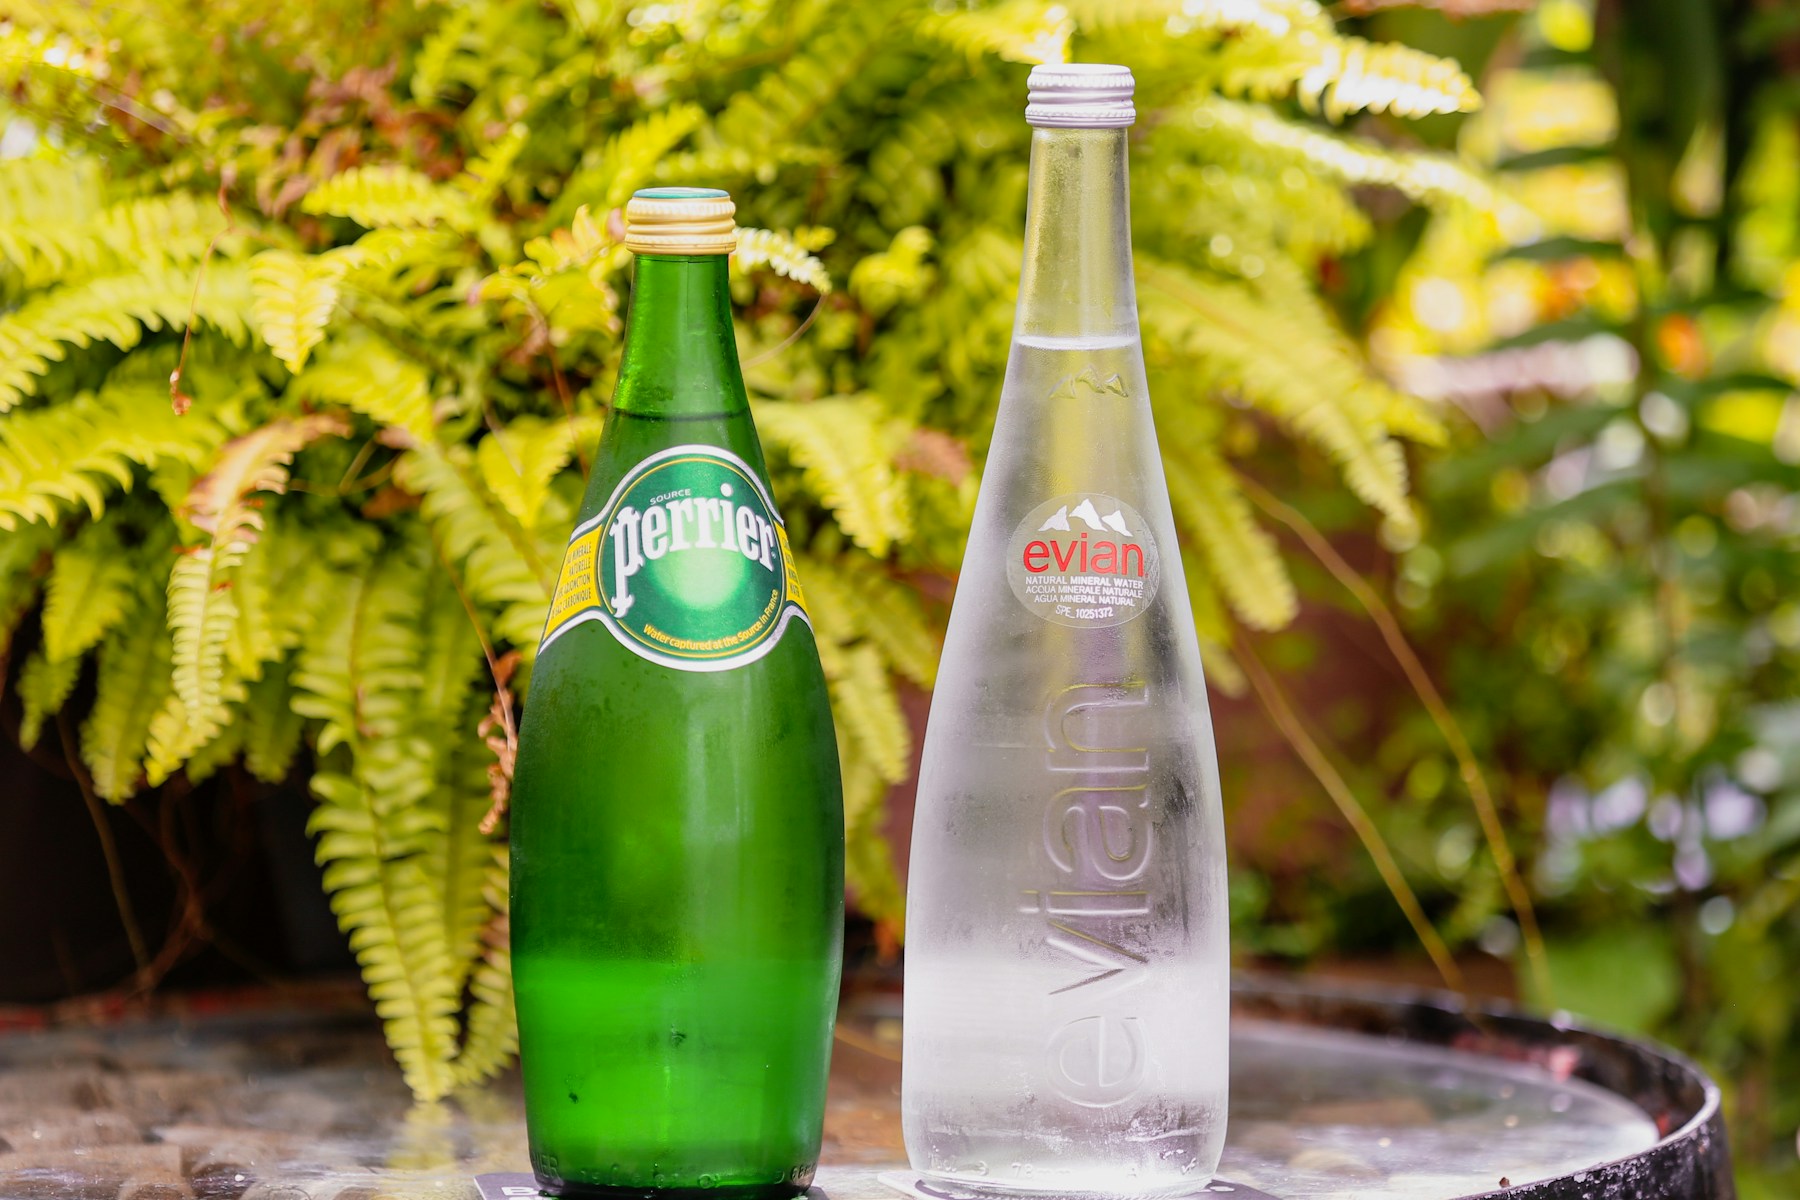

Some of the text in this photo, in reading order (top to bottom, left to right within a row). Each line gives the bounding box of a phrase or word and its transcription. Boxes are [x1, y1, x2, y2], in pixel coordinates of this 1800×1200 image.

[649, 488, 691, 506] SOURCE
[1023, 532, 1144, 577] evian
[1025, 576, 1144, 590] NATURAL MINERAL WATER
[1025, 585, 1143, 599] ACQUA MINERALE NATURALE
[763, 588, 779, 616] France
[1034, 594, 1136, 607] AGUA MINERAL NATURAL
[759, 615, 768, 625] in
[643, 623, 670, 644] Water
[737, 620, 763, 642] Source
[669, 637, 712, 651] captured
[712, 639, 724, 649] at
[722, 635, 739, 647] the
